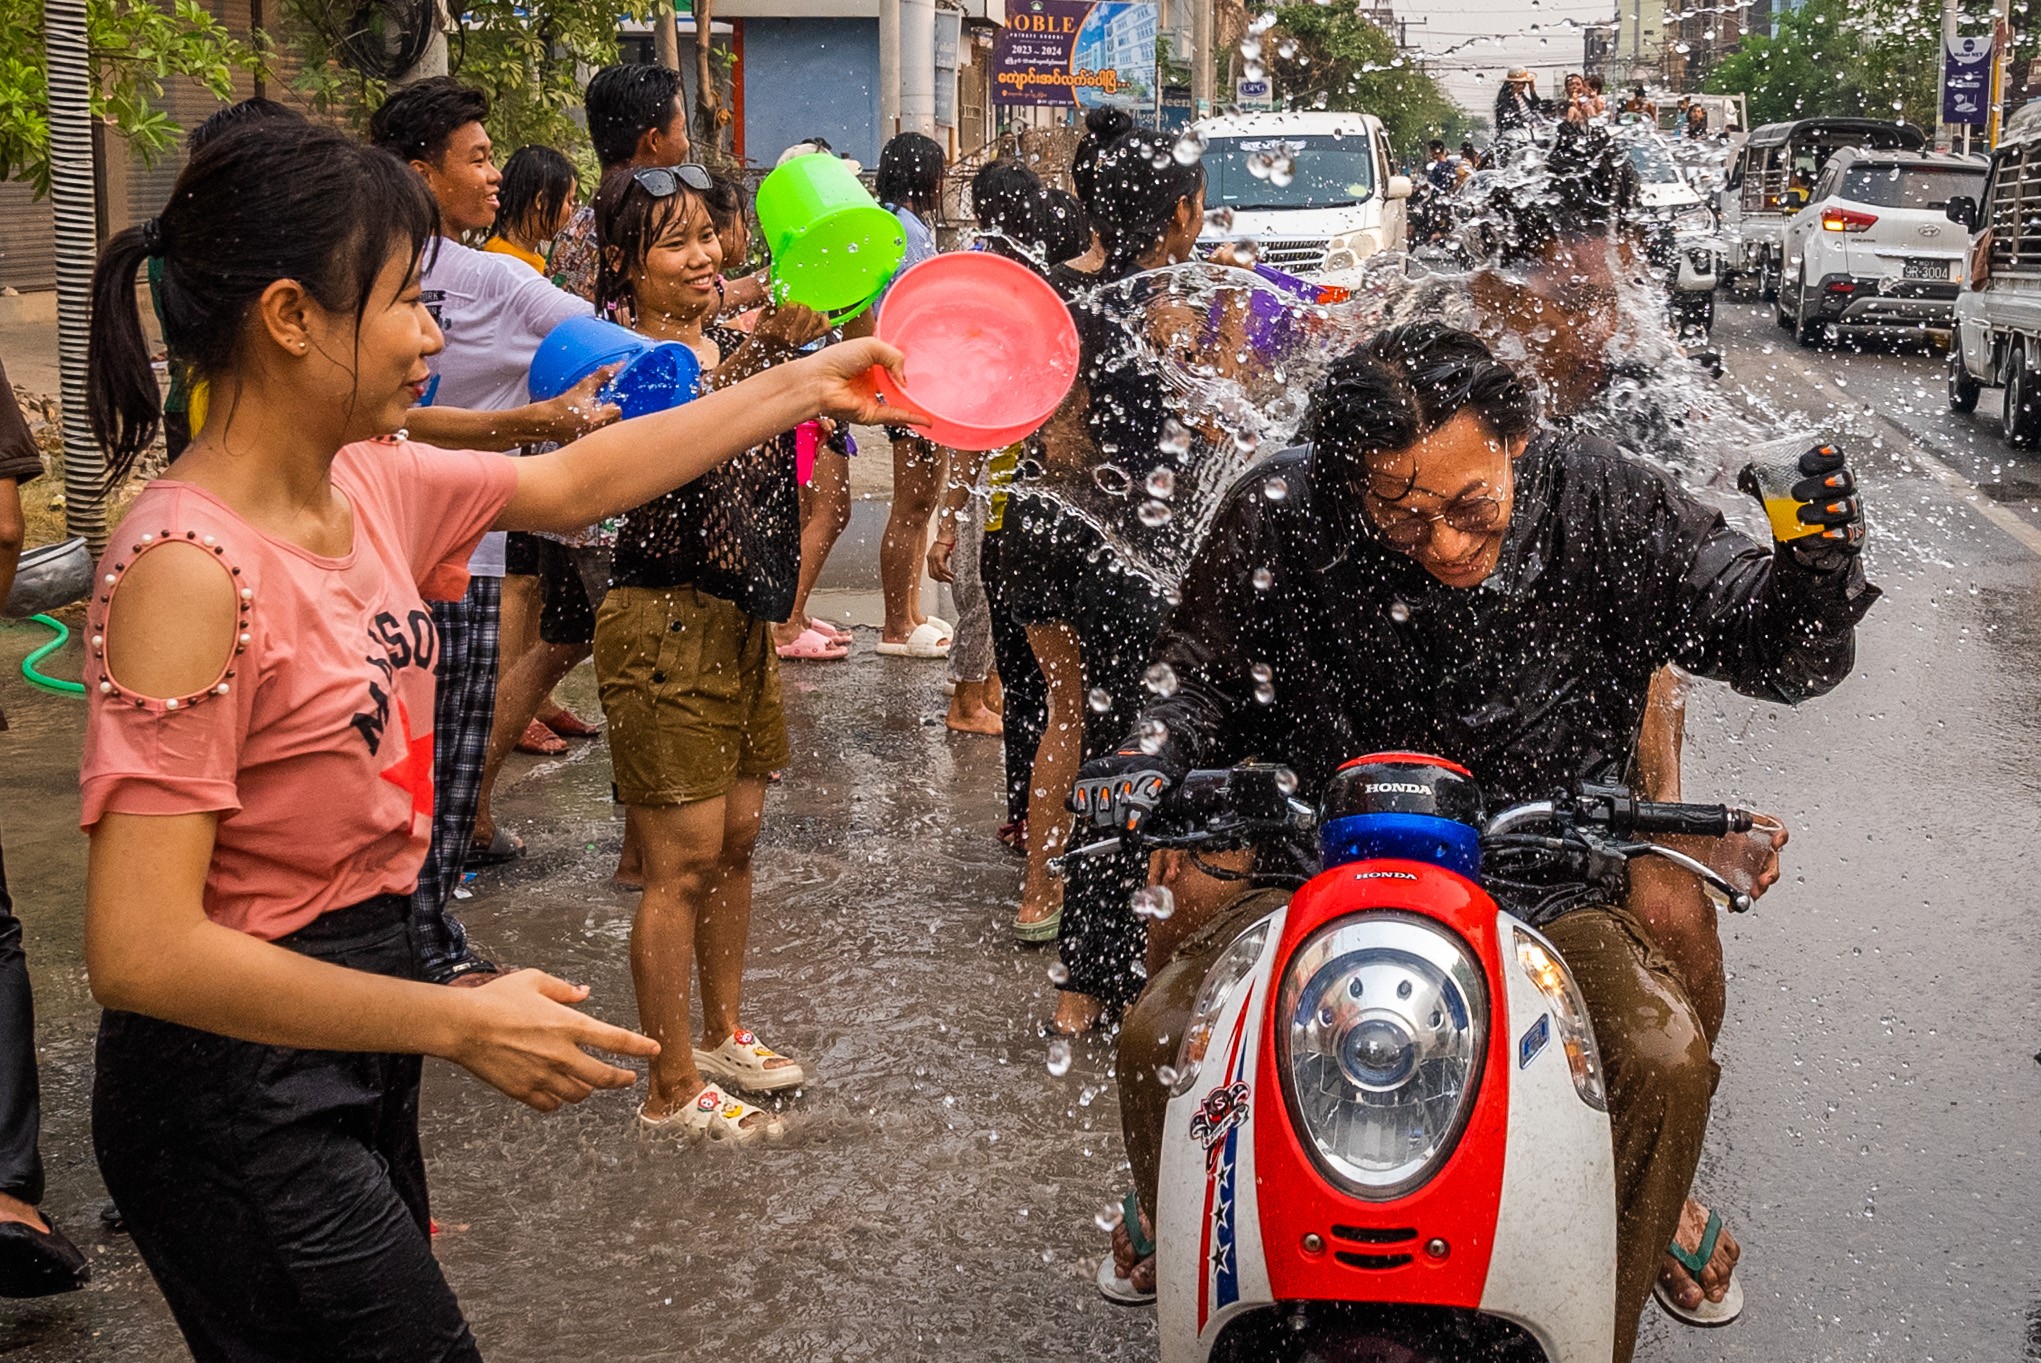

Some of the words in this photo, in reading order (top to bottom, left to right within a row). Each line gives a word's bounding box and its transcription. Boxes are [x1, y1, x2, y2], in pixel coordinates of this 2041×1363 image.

[1011, 44, 1032, 54] 2023
[1041, 45, 1062, 56] 2024
[1905, 265, 1948, 279] 9R-3004
[1365, 783, 1432, 795] HONDA
[1355, 872, 1417, 880] HONDA
